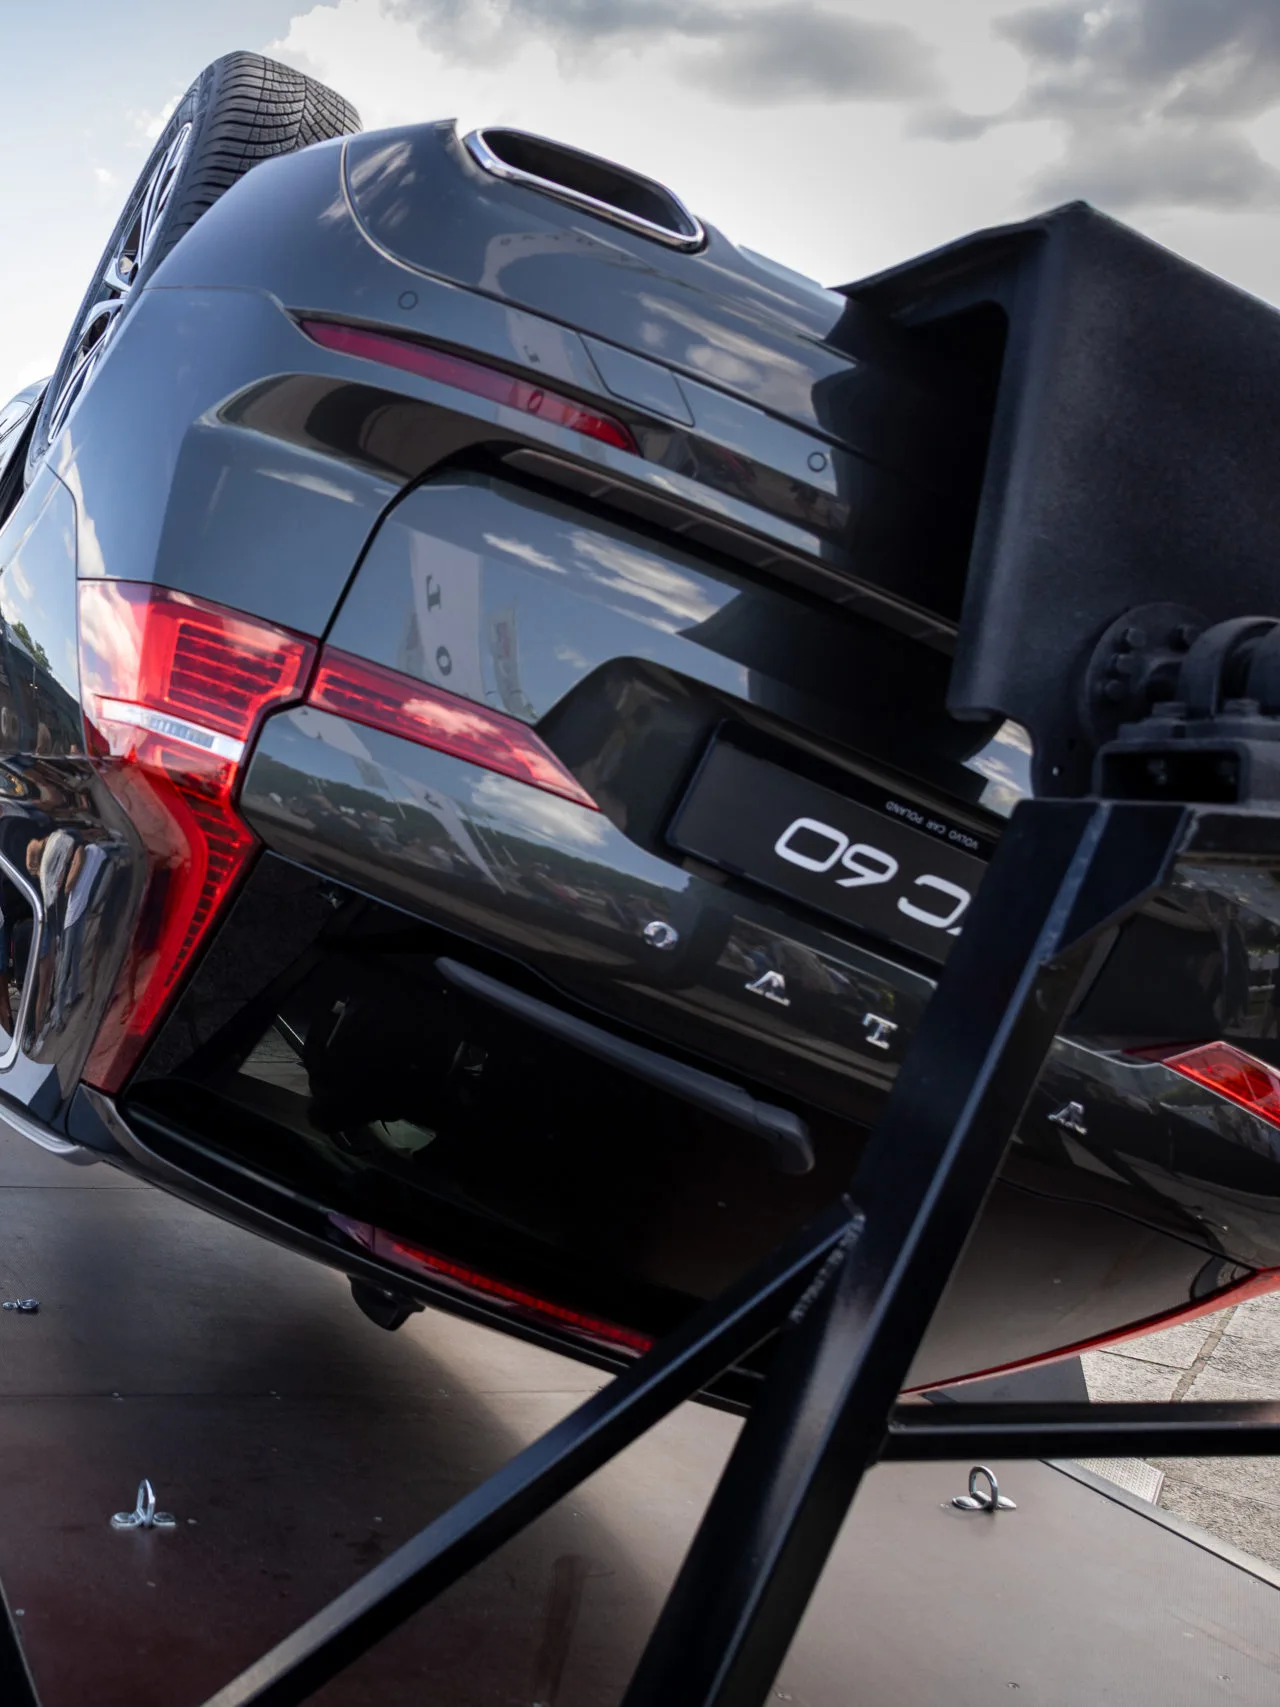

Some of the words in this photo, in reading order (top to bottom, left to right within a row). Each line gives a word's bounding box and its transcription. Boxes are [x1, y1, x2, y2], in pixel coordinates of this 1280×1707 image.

[885, 801, 924, 825] POLAND
[925, 820, 947, 834] CAR
[948, 830, 979, 850] VOLVO
[774, 817, 972, 936] C60
